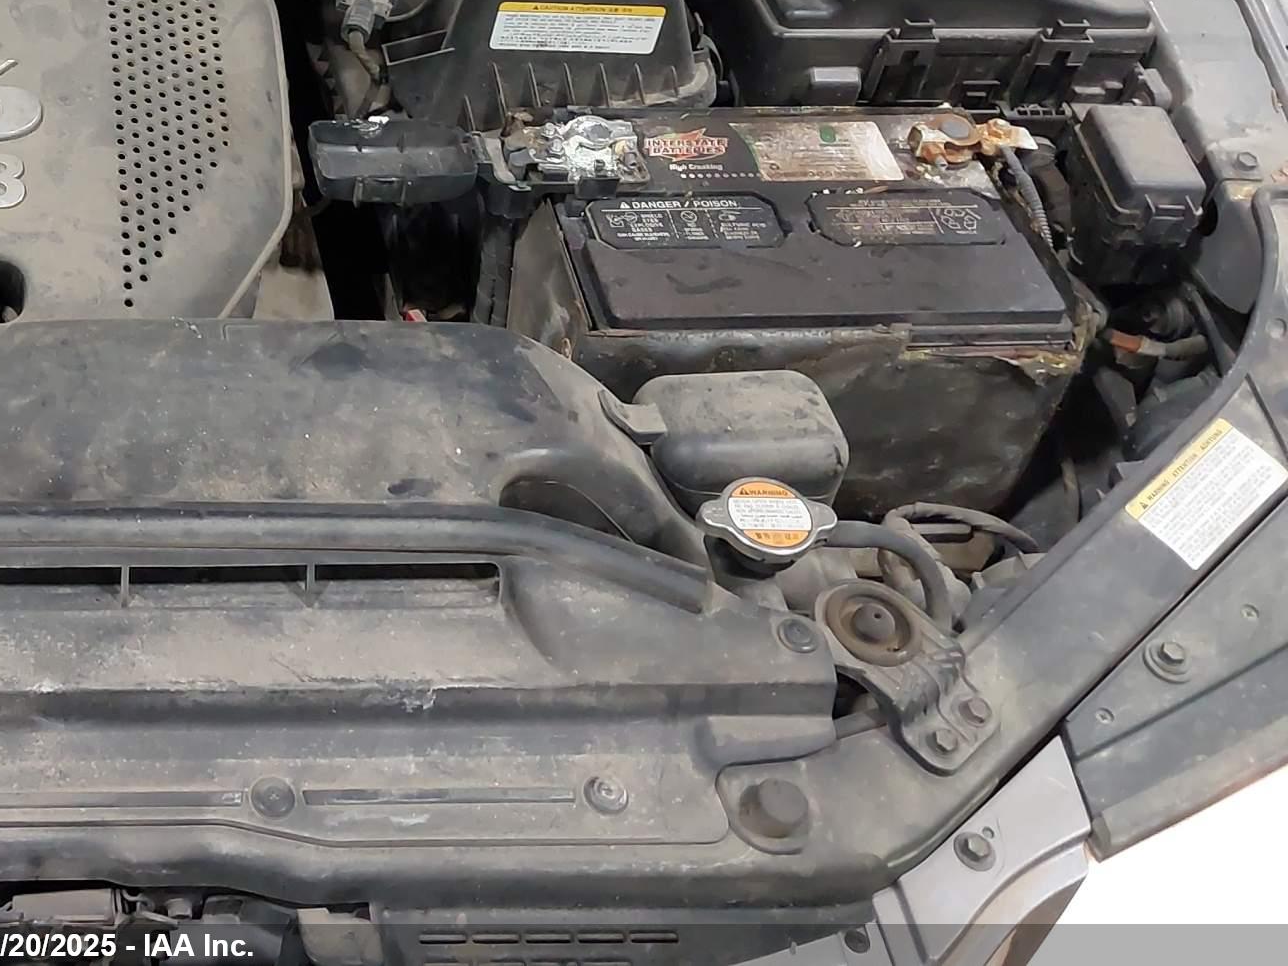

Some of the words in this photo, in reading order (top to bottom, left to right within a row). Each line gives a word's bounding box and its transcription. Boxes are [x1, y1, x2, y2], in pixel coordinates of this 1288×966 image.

[644, 137, 728, 148] INTERSTATE
[650, 147, 725, 156] BATTERIES
[632, 201, 681, 209] DANGER
[693, 200, 737, 208] POISON
[1146, 479, 1170, 502] WARNING
